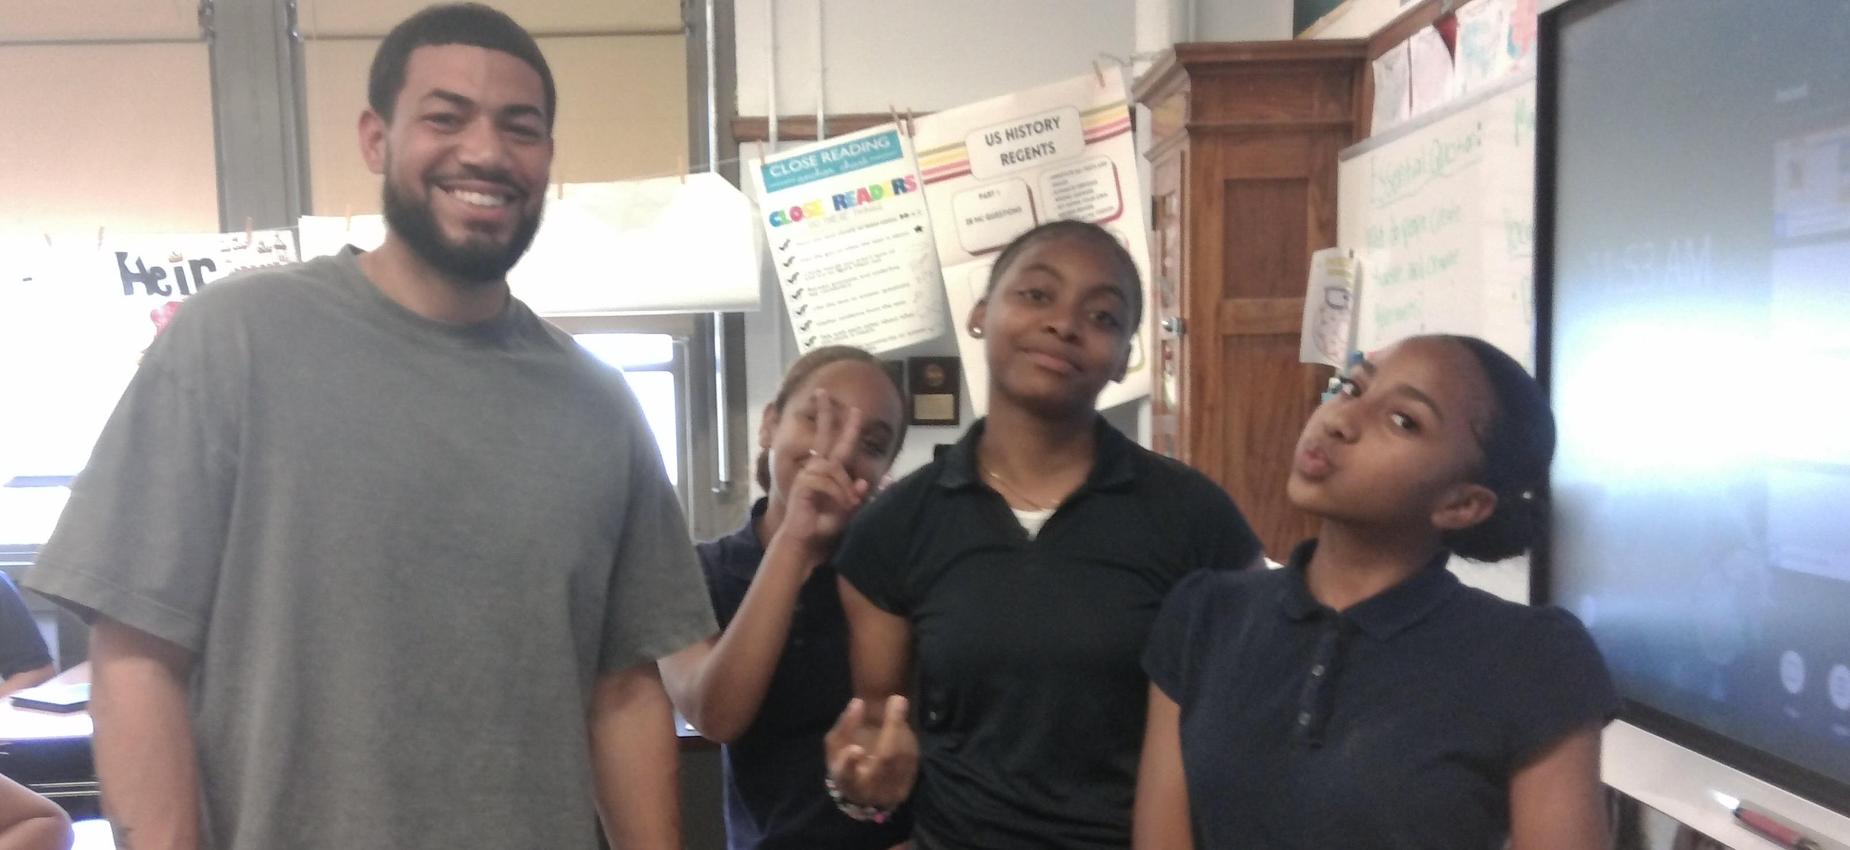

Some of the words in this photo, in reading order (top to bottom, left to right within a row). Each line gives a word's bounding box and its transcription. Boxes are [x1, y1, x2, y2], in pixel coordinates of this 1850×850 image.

[985, 131, 1002, 147] US
[1005, 116, 1061, 141] HISTORY
[769, 155, 818, 177] CLOSE
[819, 135, 891, 163] READING
[1000, 141, 1056, 166] REGENTS
